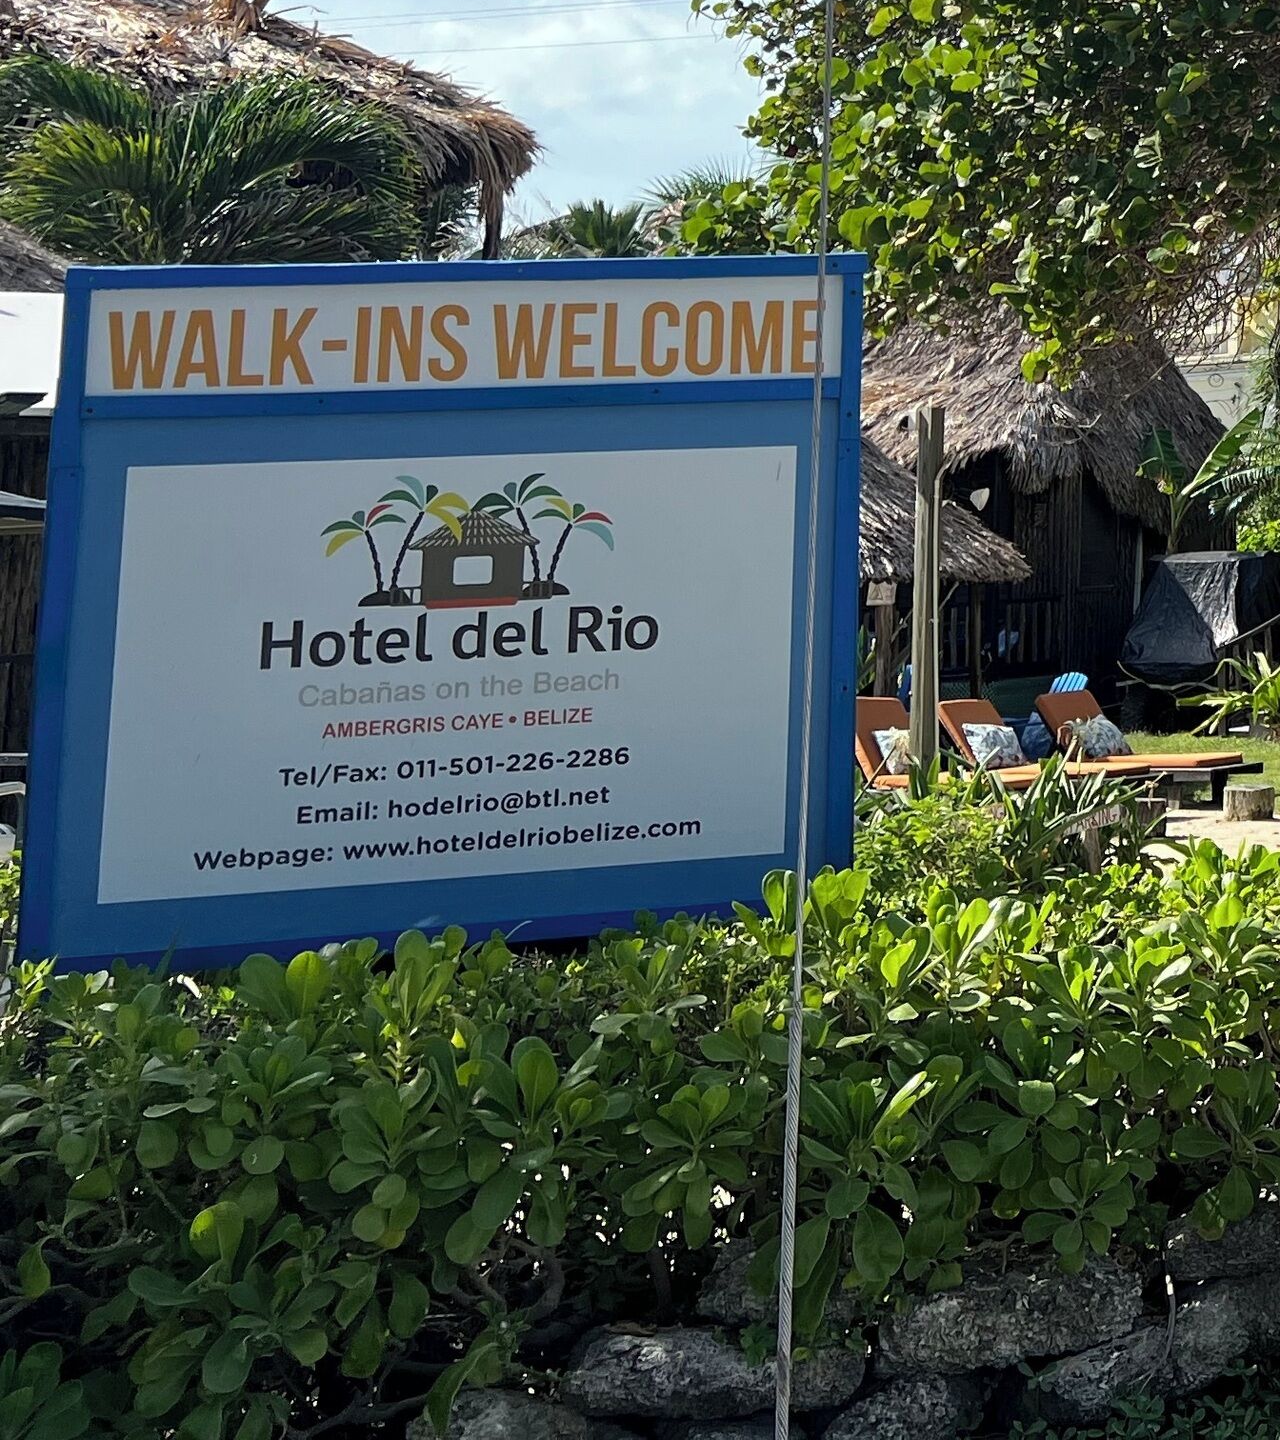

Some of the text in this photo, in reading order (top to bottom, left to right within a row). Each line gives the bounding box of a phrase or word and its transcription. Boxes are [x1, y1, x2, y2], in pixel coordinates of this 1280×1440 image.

[109, 299, 826, 390] WALK-INS WELCOME
[260, 604, 660, 670] Hotel del Rio
[298, 668, 621, 708] Cabañas on the Beach
[322, 707, 593, 739] AMBERGRIS CAYE BELIZE
[279, 746, 630, 788] Tel/Fax: 011-501-226-2286
[296, 786, 610, 825] Email: hodelrio@btl.net
[194, 817, 702, 871] Webpage: www.hoteldelriobelize.com
